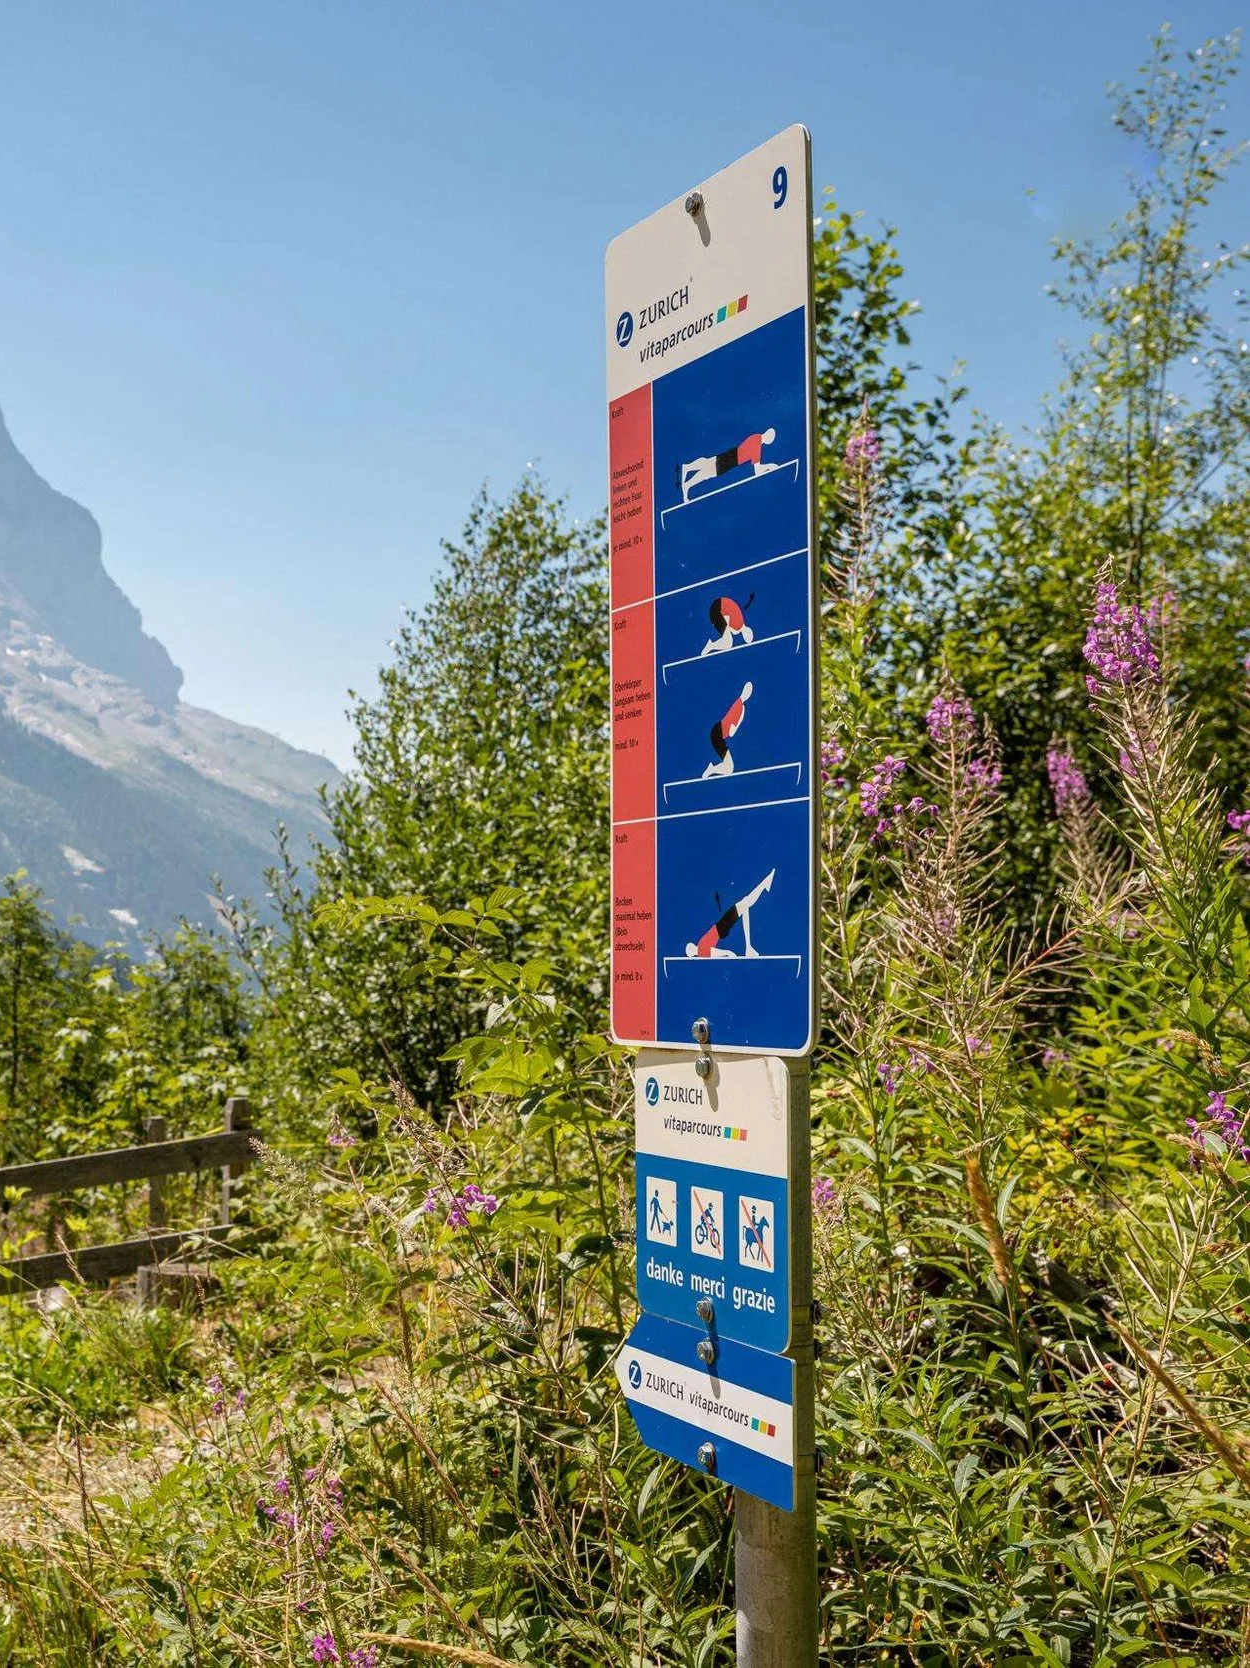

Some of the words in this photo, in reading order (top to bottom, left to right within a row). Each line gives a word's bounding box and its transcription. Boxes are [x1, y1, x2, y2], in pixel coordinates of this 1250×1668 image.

[772, 166, 788, 210] 9
[639, 286, 689, 330] ZURICH
[639, 312, 714, 363] vitaparcours
[613, 618, 627, 631] Kraft
[615, 833, 628, 844] Kraft
[663, 1085, 703, 1106] ZURICH
[663, 1114, 722, 1138] vitaparcours
[646, 1256, 684, 1287] danke
[690, 1272, 726, 1299] merci
[732, 1285, 776, 1314] grazie
[646, 1372, 684, 1401] ZURICH
[690, 1391, 749, 1427] vitaparcours
